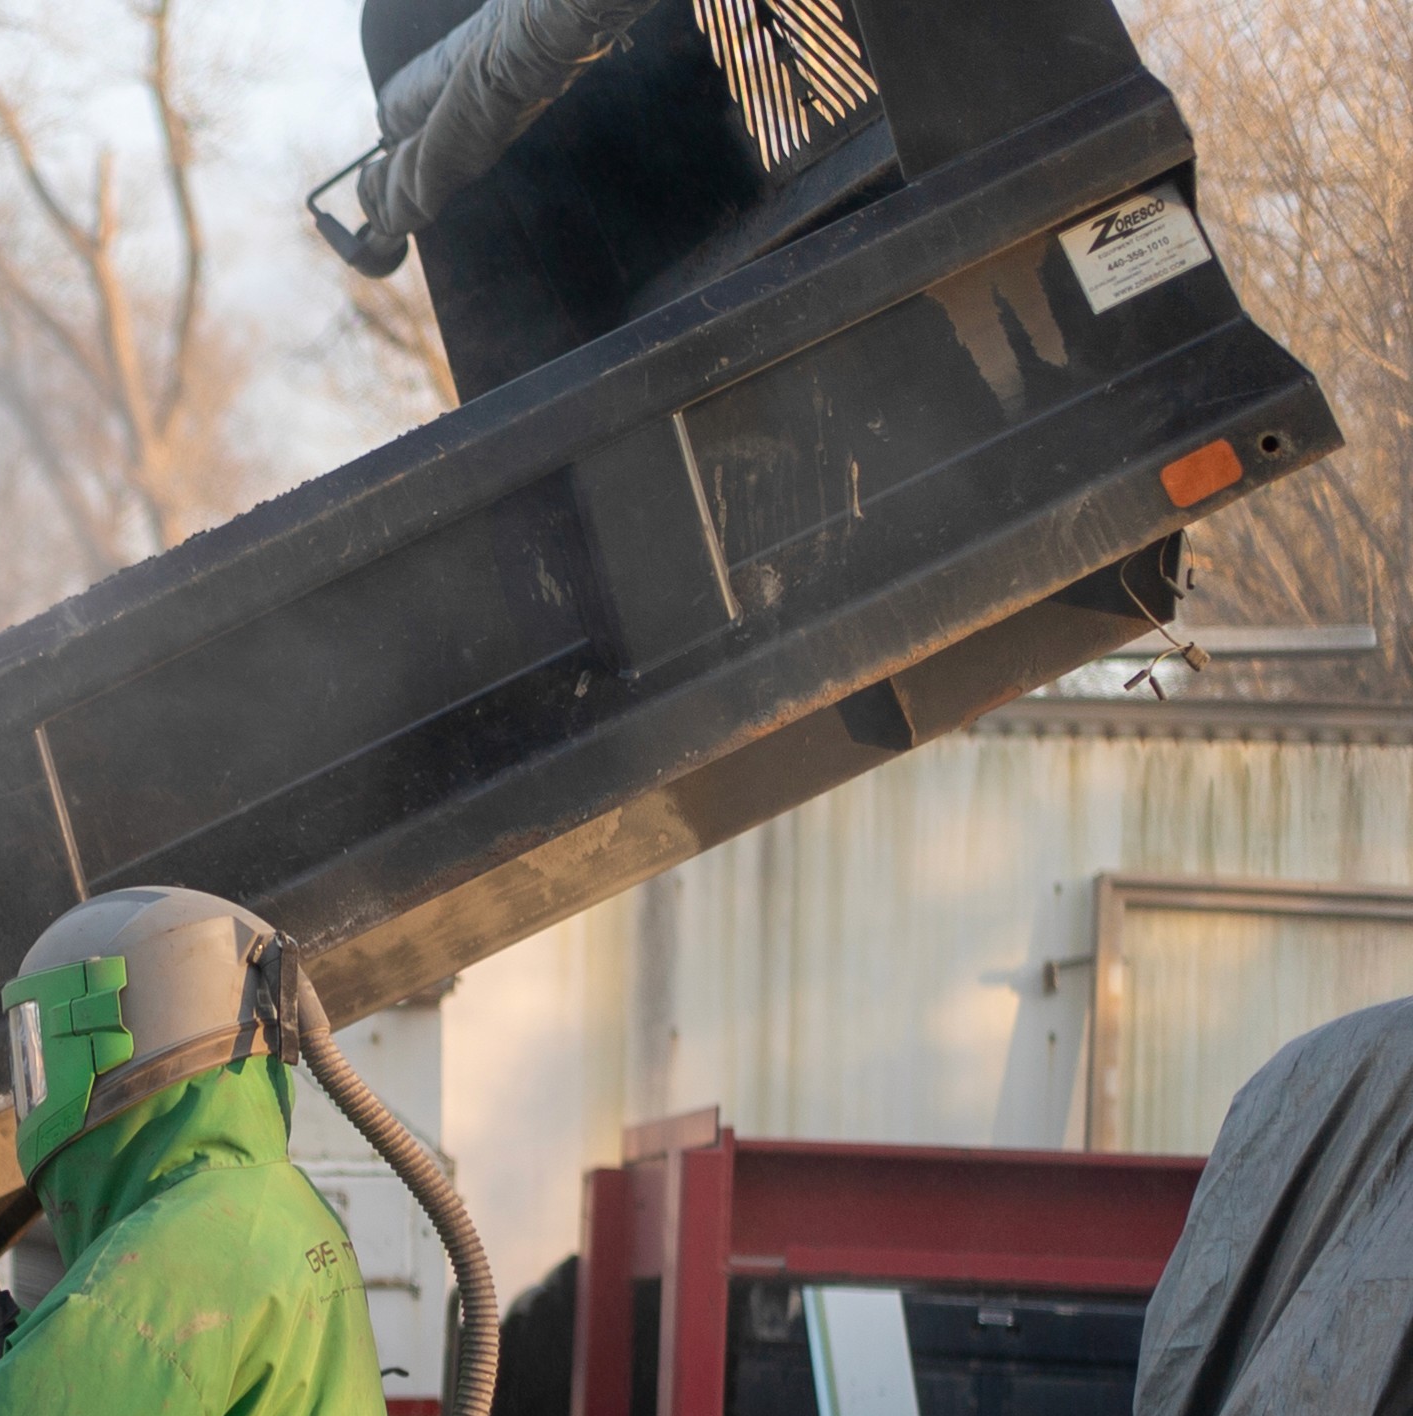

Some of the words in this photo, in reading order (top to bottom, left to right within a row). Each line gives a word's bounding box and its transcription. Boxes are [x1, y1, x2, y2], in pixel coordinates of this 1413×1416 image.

[1087, 199, 1165, 255] ZORESCO
[1097, 240, 1134, 259] EQUIPMENT
[1135, 223, 1166, 241] COMPANY
[1108, 236, 1170, 271] 440-359-1010
[305, 1241, 338, 1273] GVS
